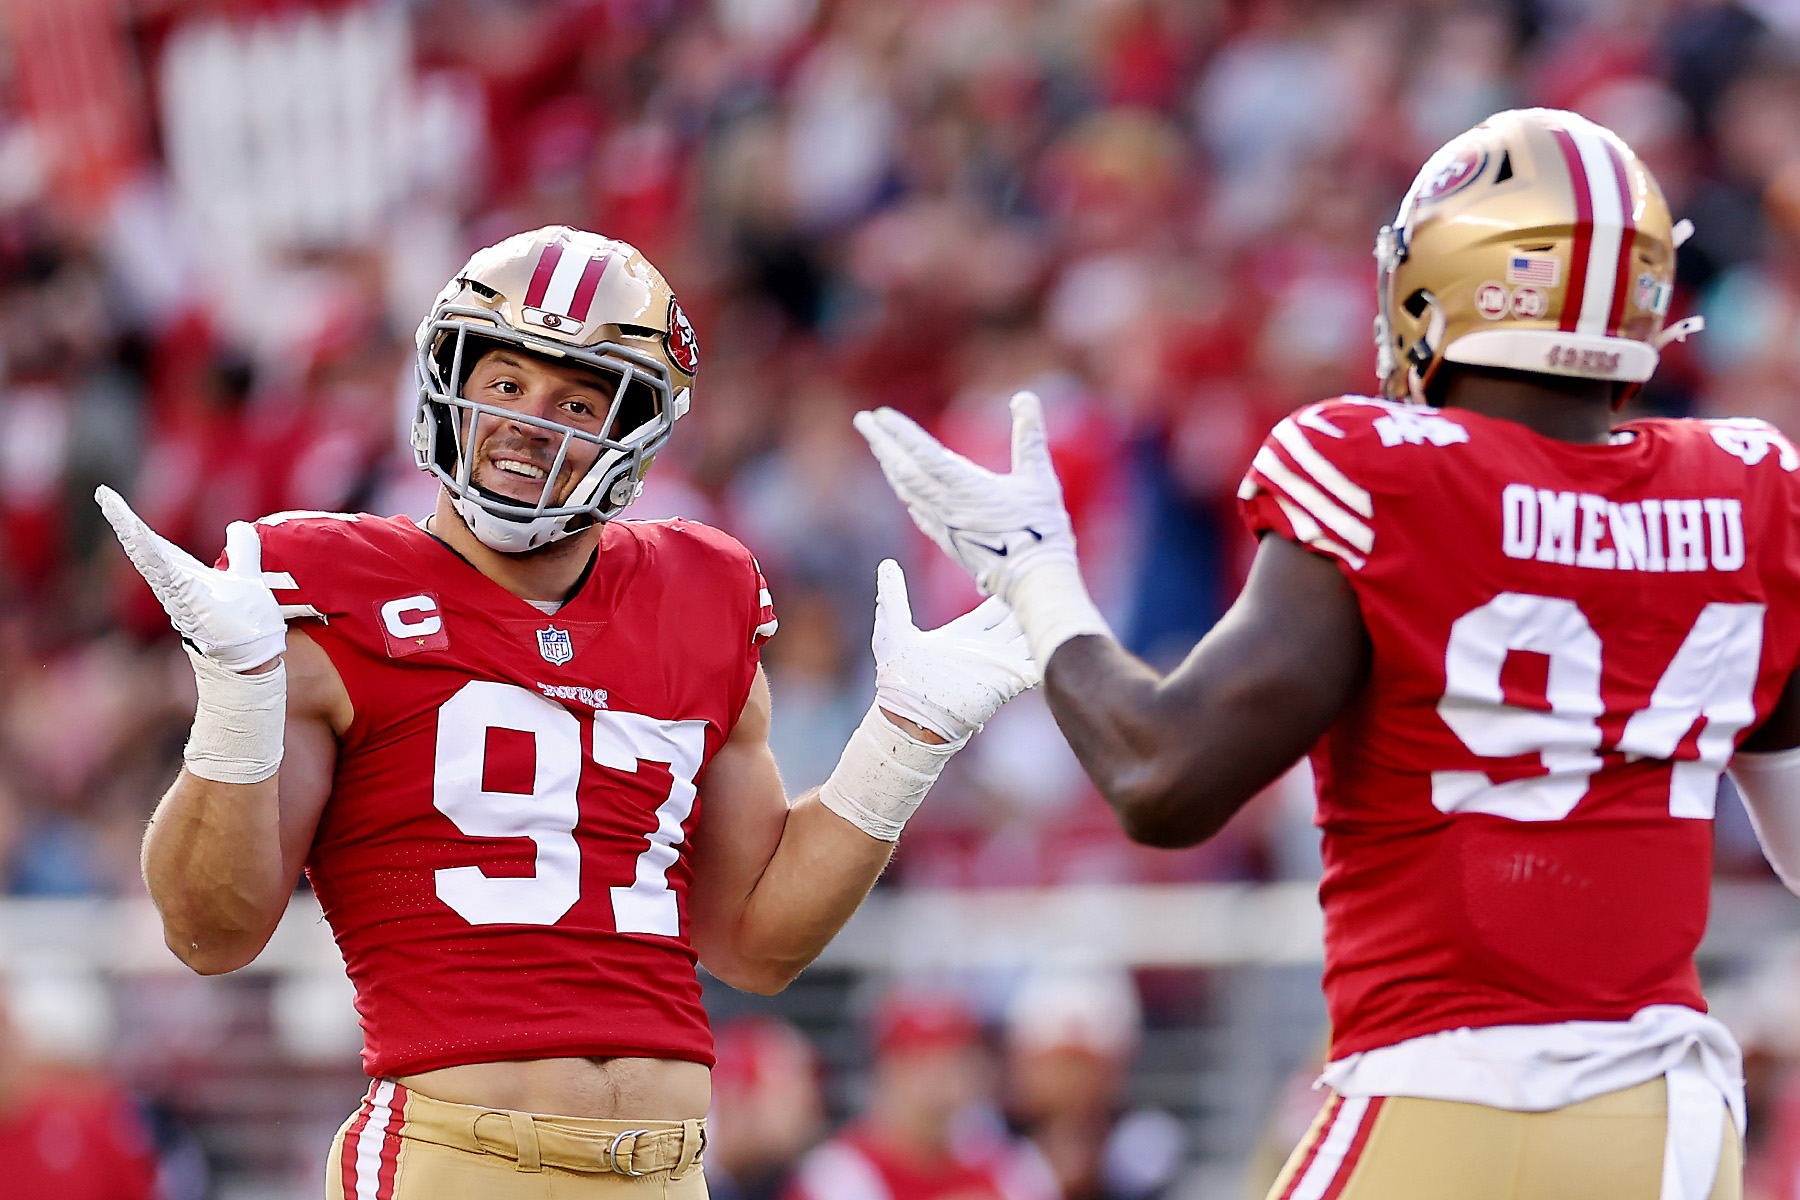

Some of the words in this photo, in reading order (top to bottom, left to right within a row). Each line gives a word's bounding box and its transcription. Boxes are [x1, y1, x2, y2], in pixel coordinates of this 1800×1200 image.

[1502, 484, 1746, 573] OMENIHU
[380, 594, 442, 638] C
[545, 643, 568, 658] NFL
[1431, 591, 1768, 822] 94
[433, 679, 709, 937] 97
